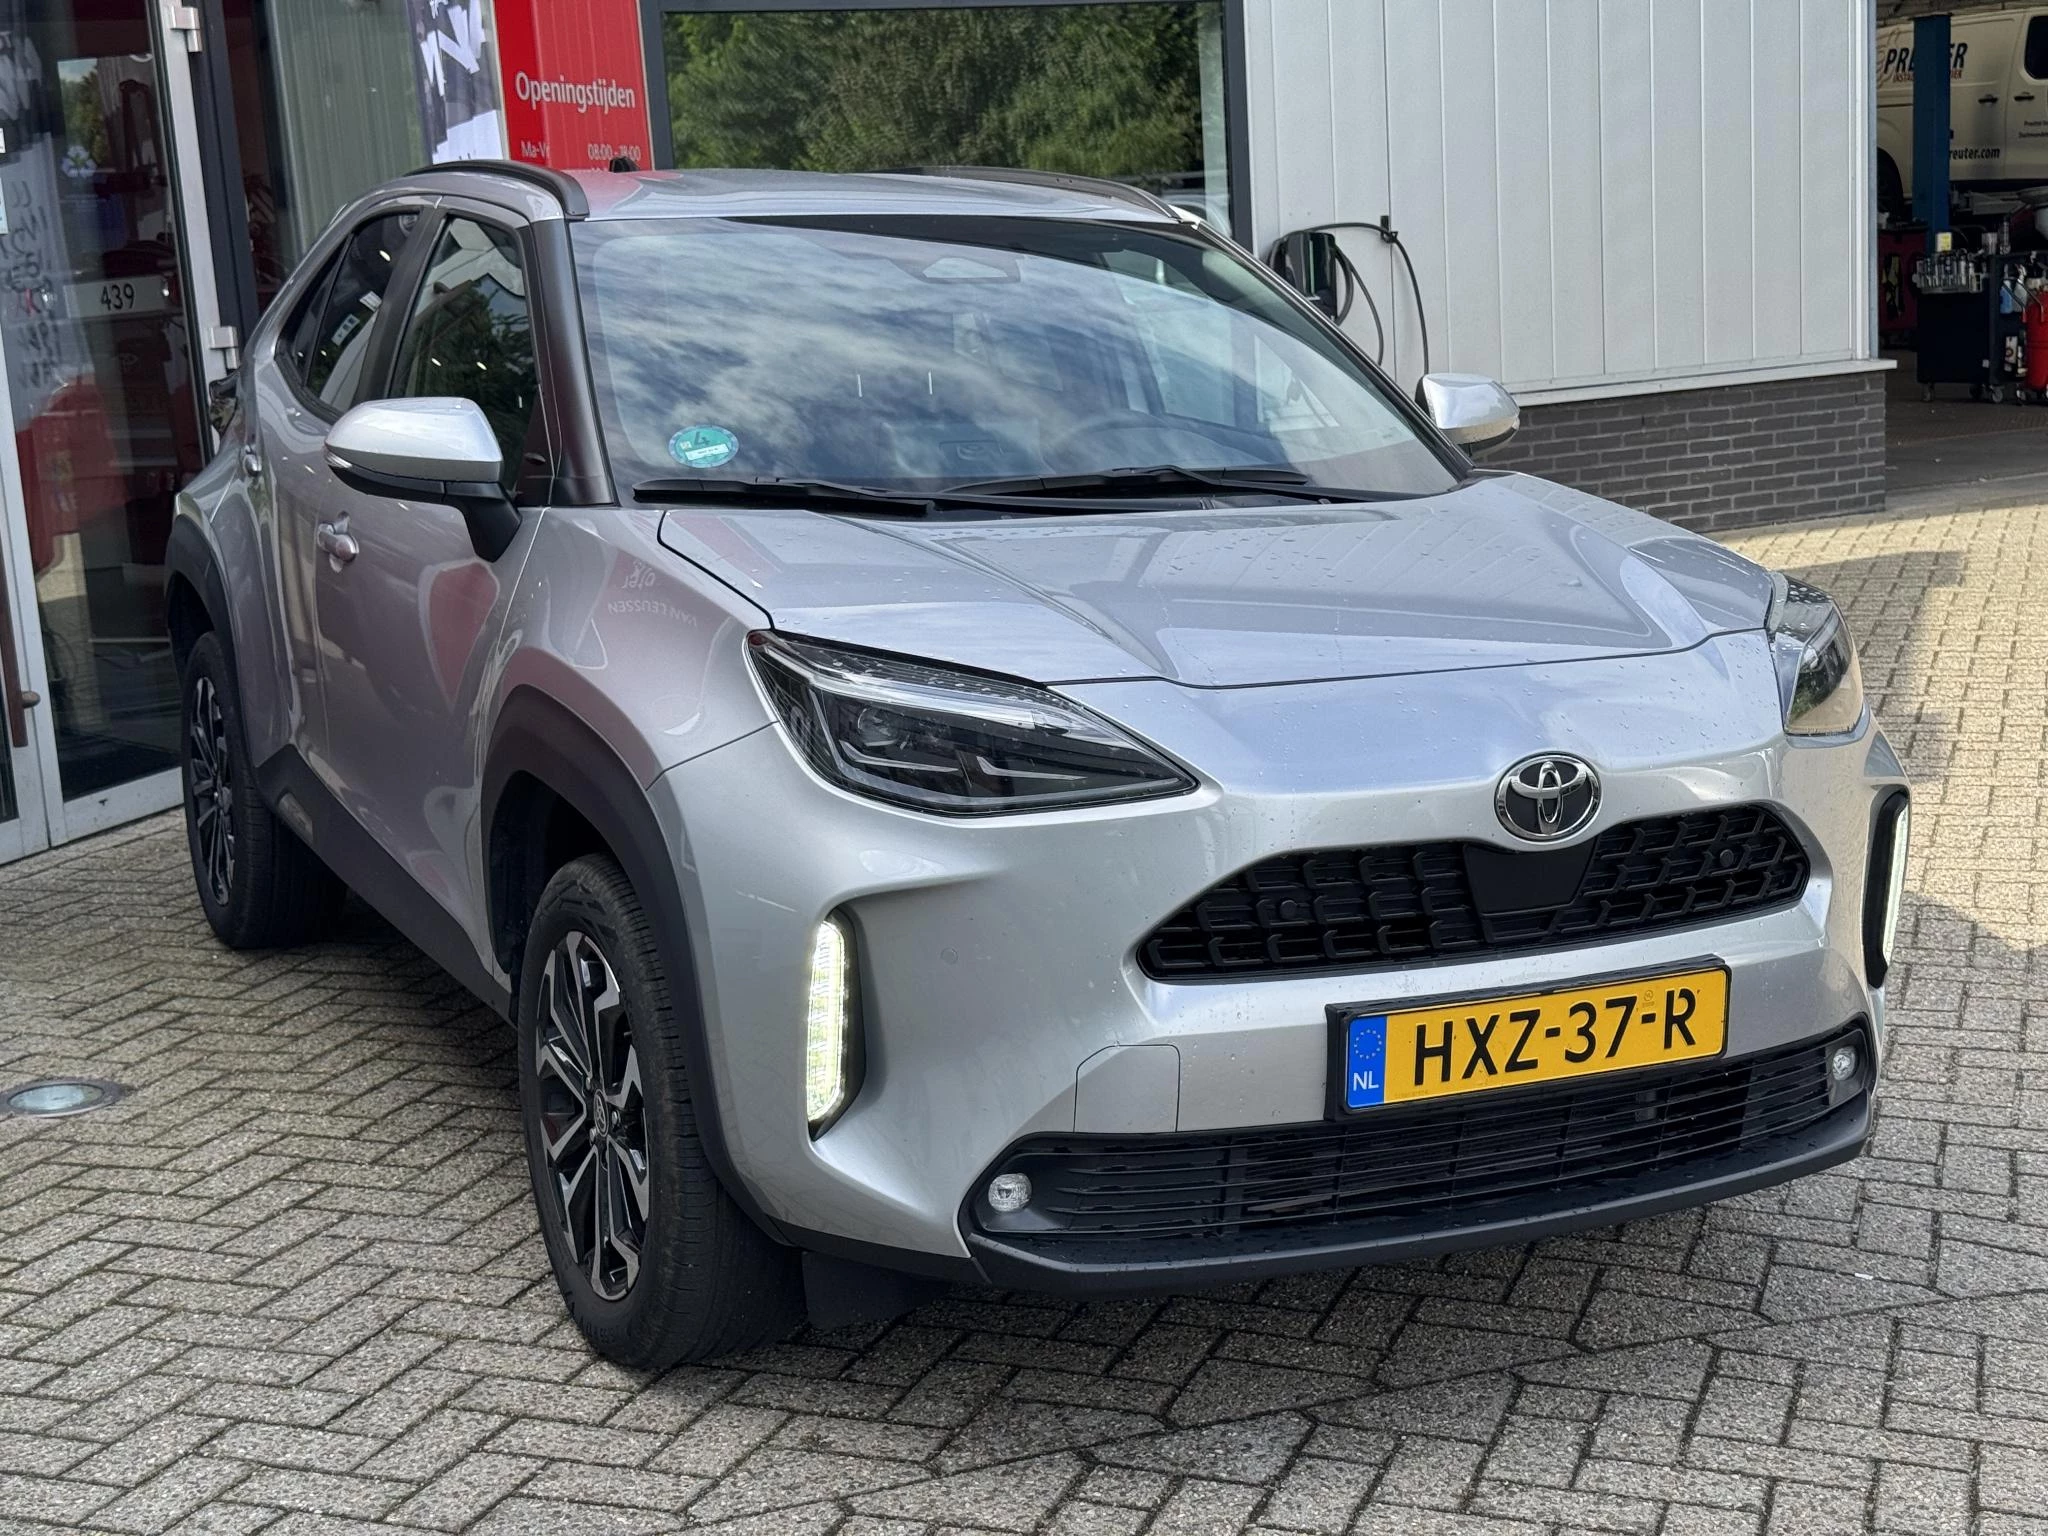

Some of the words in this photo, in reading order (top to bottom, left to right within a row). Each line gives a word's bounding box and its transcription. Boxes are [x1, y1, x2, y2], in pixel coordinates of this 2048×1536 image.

[515, 71, 635, 114] Openingstijden
[101, 284, 134, 311] 439
[1414, 988, 1698, 1086] HXZ-37-R
[1353, 1071, 1379, 1091] NL
